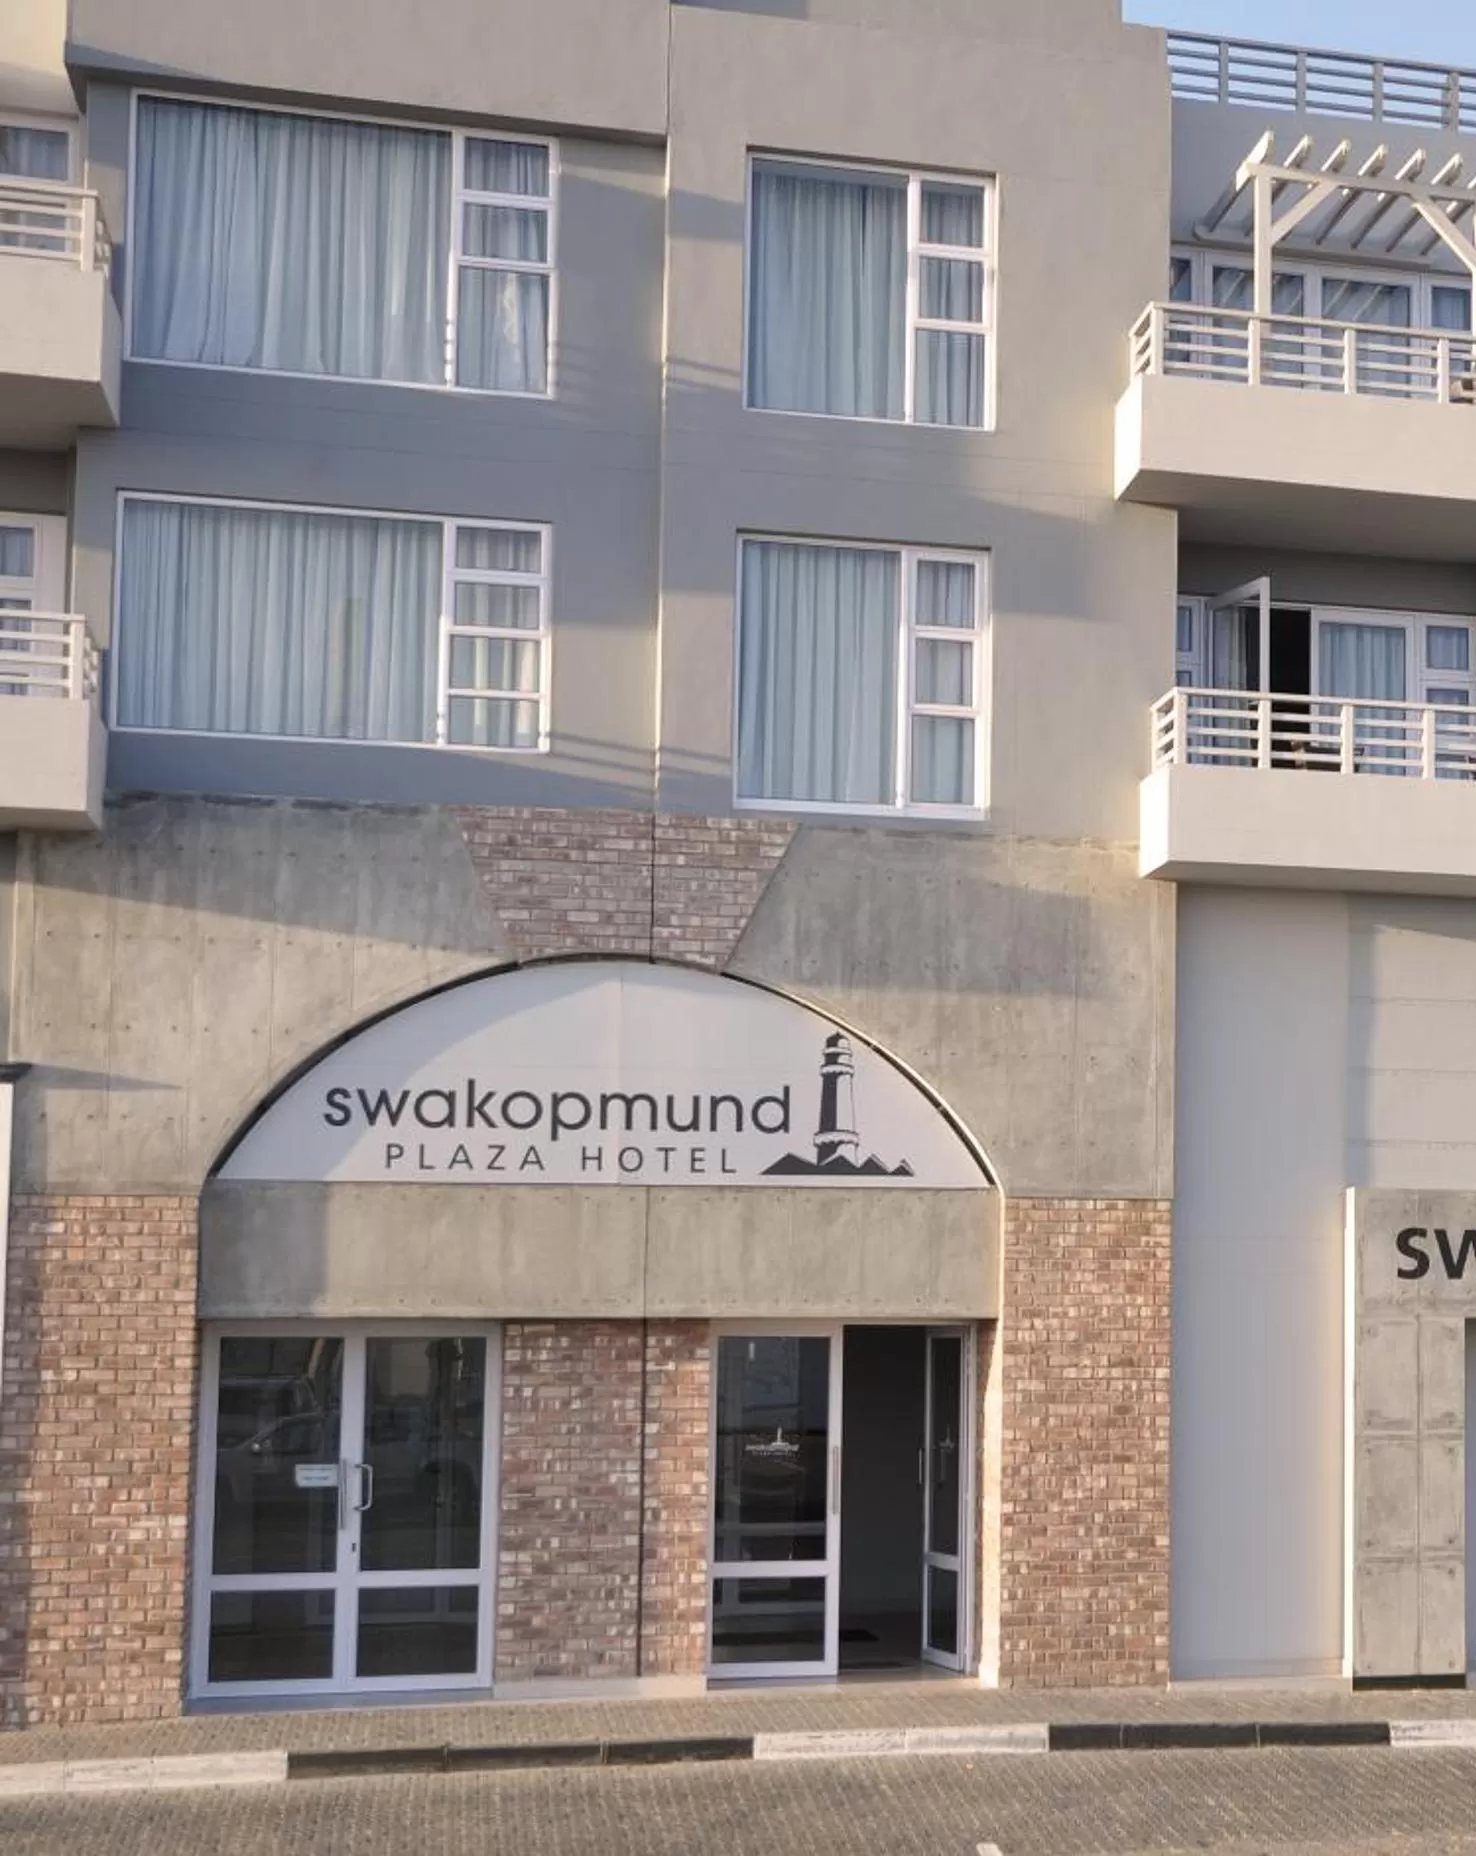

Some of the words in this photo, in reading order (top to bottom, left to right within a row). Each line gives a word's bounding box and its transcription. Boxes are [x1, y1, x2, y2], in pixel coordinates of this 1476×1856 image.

[322, 1078, 791, 1141] swakopmund
[385, 1143, 546, 1172] PLAZA
[580, 1145, 737, 1174] HOTEL
